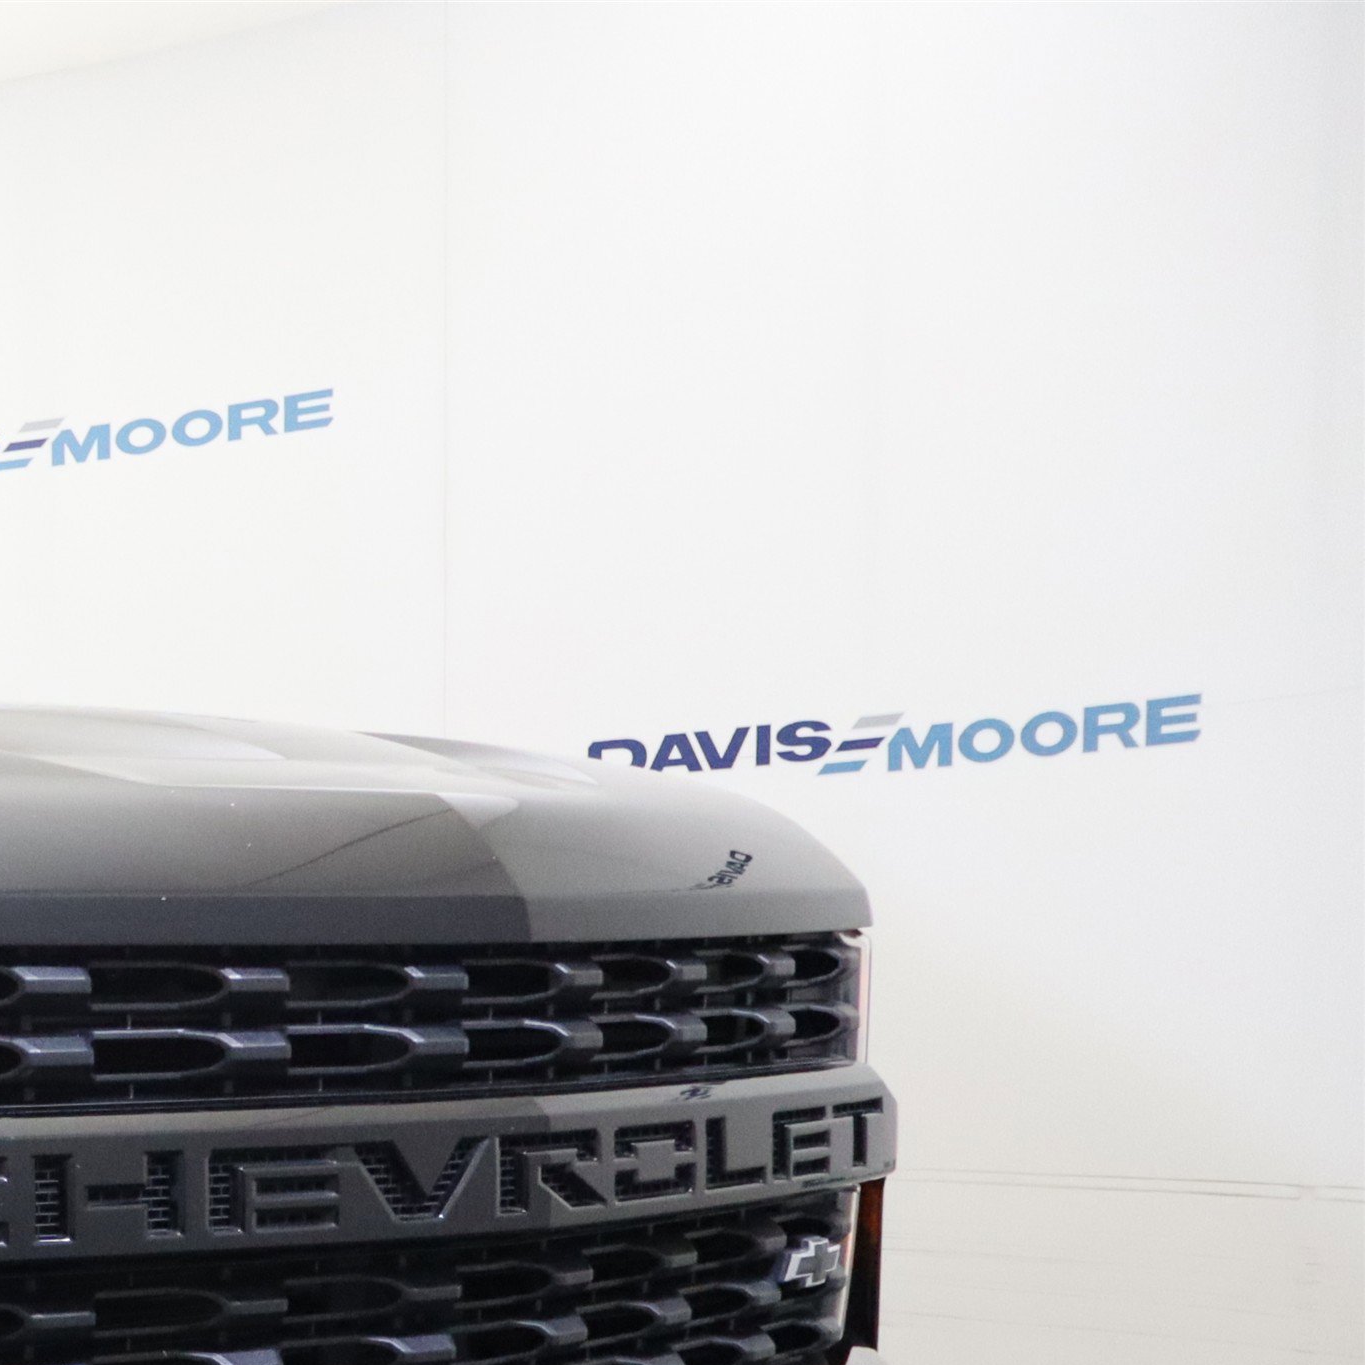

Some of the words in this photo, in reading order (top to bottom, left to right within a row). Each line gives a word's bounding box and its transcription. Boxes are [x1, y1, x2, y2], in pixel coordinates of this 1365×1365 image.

[50, 388, 335, 467] MOORE
[587, 720, 832, 772] DAVIS
[887, 693, 1203, 772] MOORE
